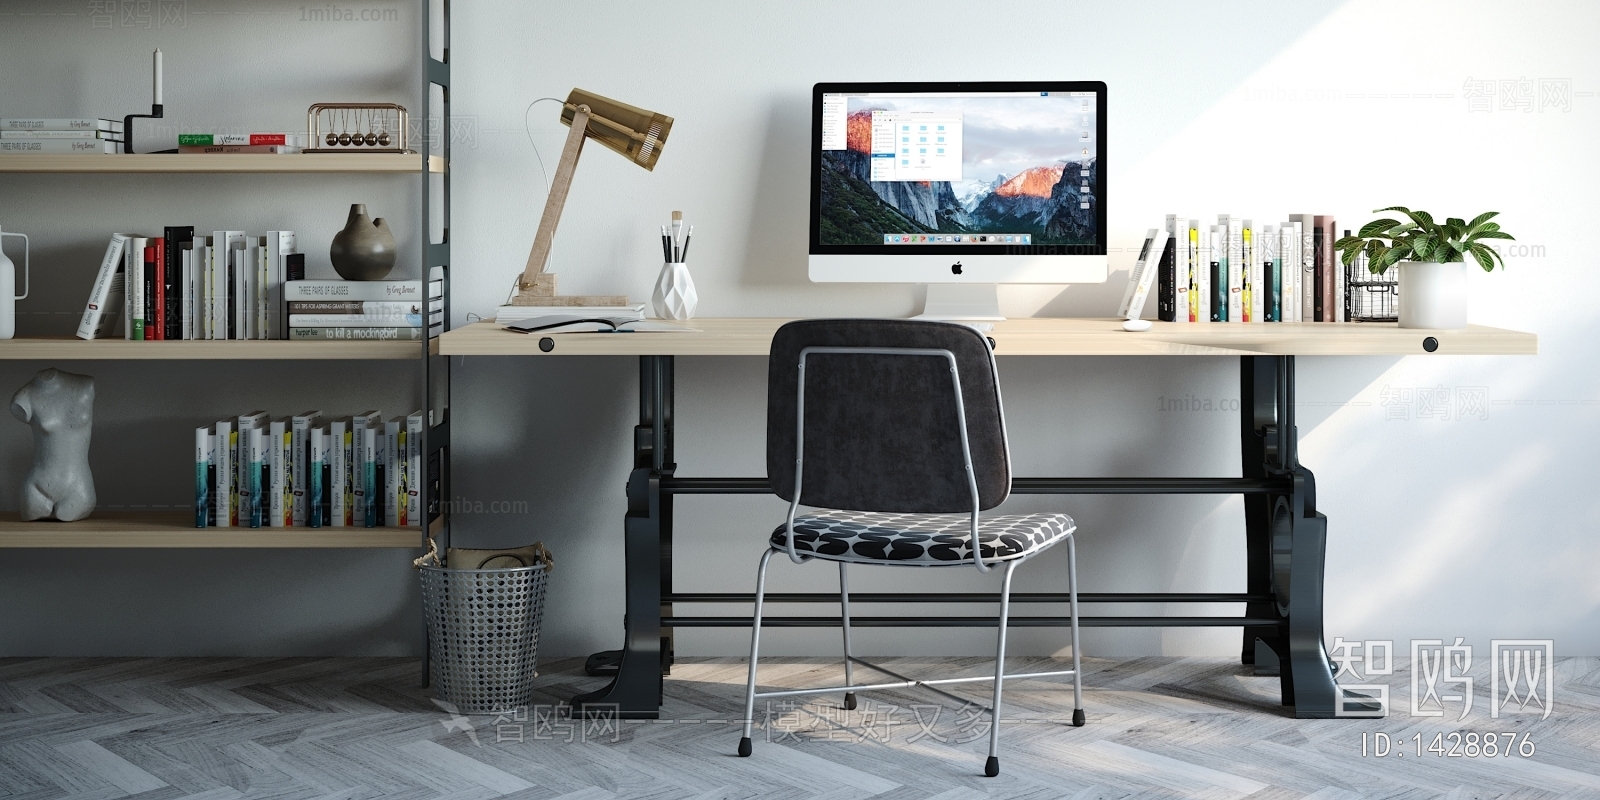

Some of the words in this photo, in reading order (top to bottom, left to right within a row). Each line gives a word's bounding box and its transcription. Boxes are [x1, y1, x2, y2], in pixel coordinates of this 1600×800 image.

[298, 286, 311, 295] THREE
[312, 286, 323, 295] PAIRS
[325, 286, 330, 295] OF
[331, 286, 348, 295] GLASSES
[386, 285, 391, 296] by
[392, 285, 401, 296] Greg
[296, 328, 310, 337] harper
[326, 328, 333, 339] to
[335, 328, 345, 339] kill
[353, 328, 398, 340] mockingbird
